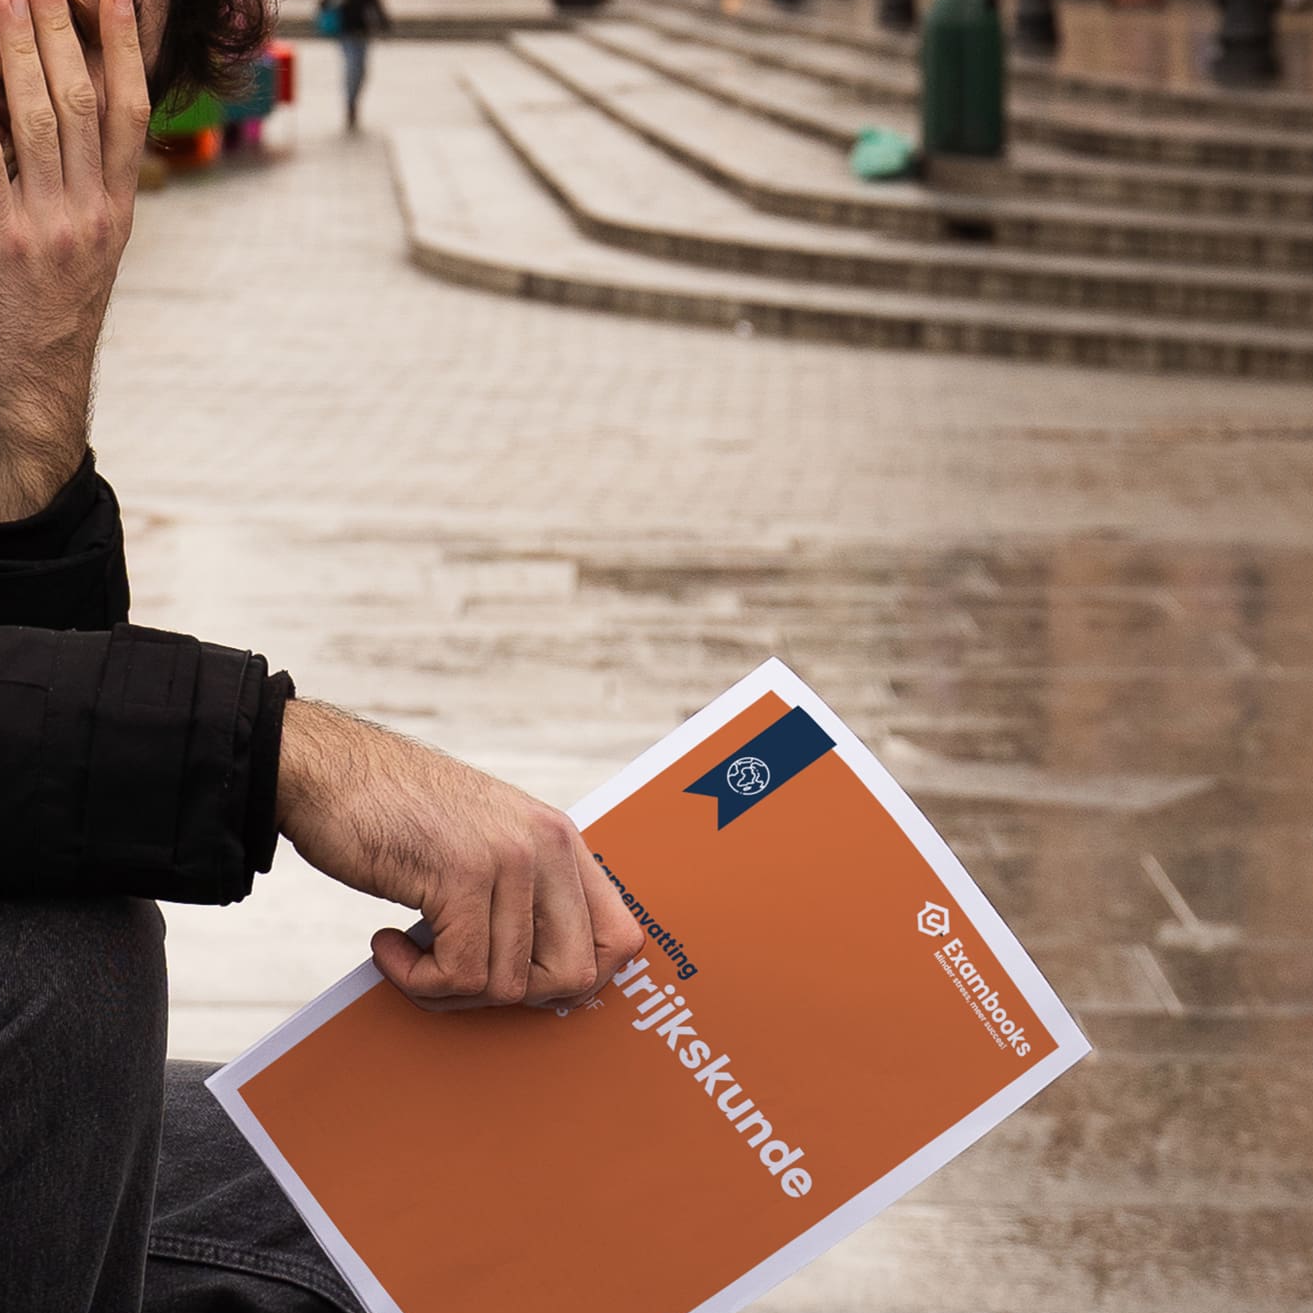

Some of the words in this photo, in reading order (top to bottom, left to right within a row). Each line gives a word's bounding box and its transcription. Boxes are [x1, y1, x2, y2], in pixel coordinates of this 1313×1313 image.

[933, 951, 955, 978] Minder
[953, 976, 972, 1004] stress,
[970, 1000, 987, 1023] meer
[984, 1020, 1007, 1050] succes!
[943, 938, 1031, 1057] Exambooks
